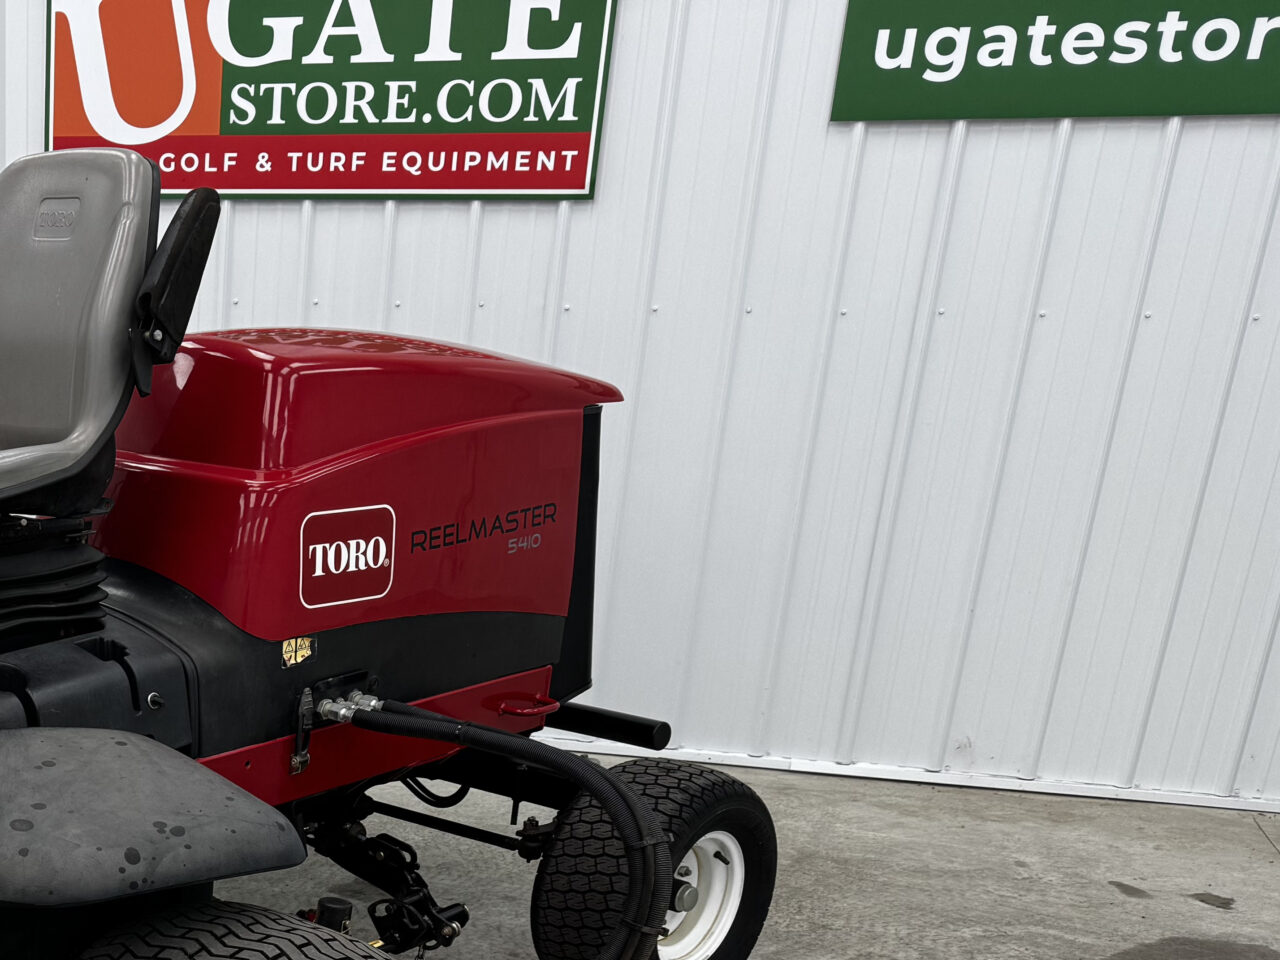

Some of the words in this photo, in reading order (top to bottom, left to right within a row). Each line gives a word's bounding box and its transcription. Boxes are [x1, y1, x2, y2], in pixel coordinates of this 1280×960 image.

[229, 77, 583, 126] STORE.COM
[158, 152, 238, 173] GOLF
[255, 152, 272, 172] &
[287, 151, 367, 172] TURF
[381, 150, 579, 175] EQUIPMENT
[410, 502, 558, 554] REELMASTER
[507, 533, 542, 554] 5410
